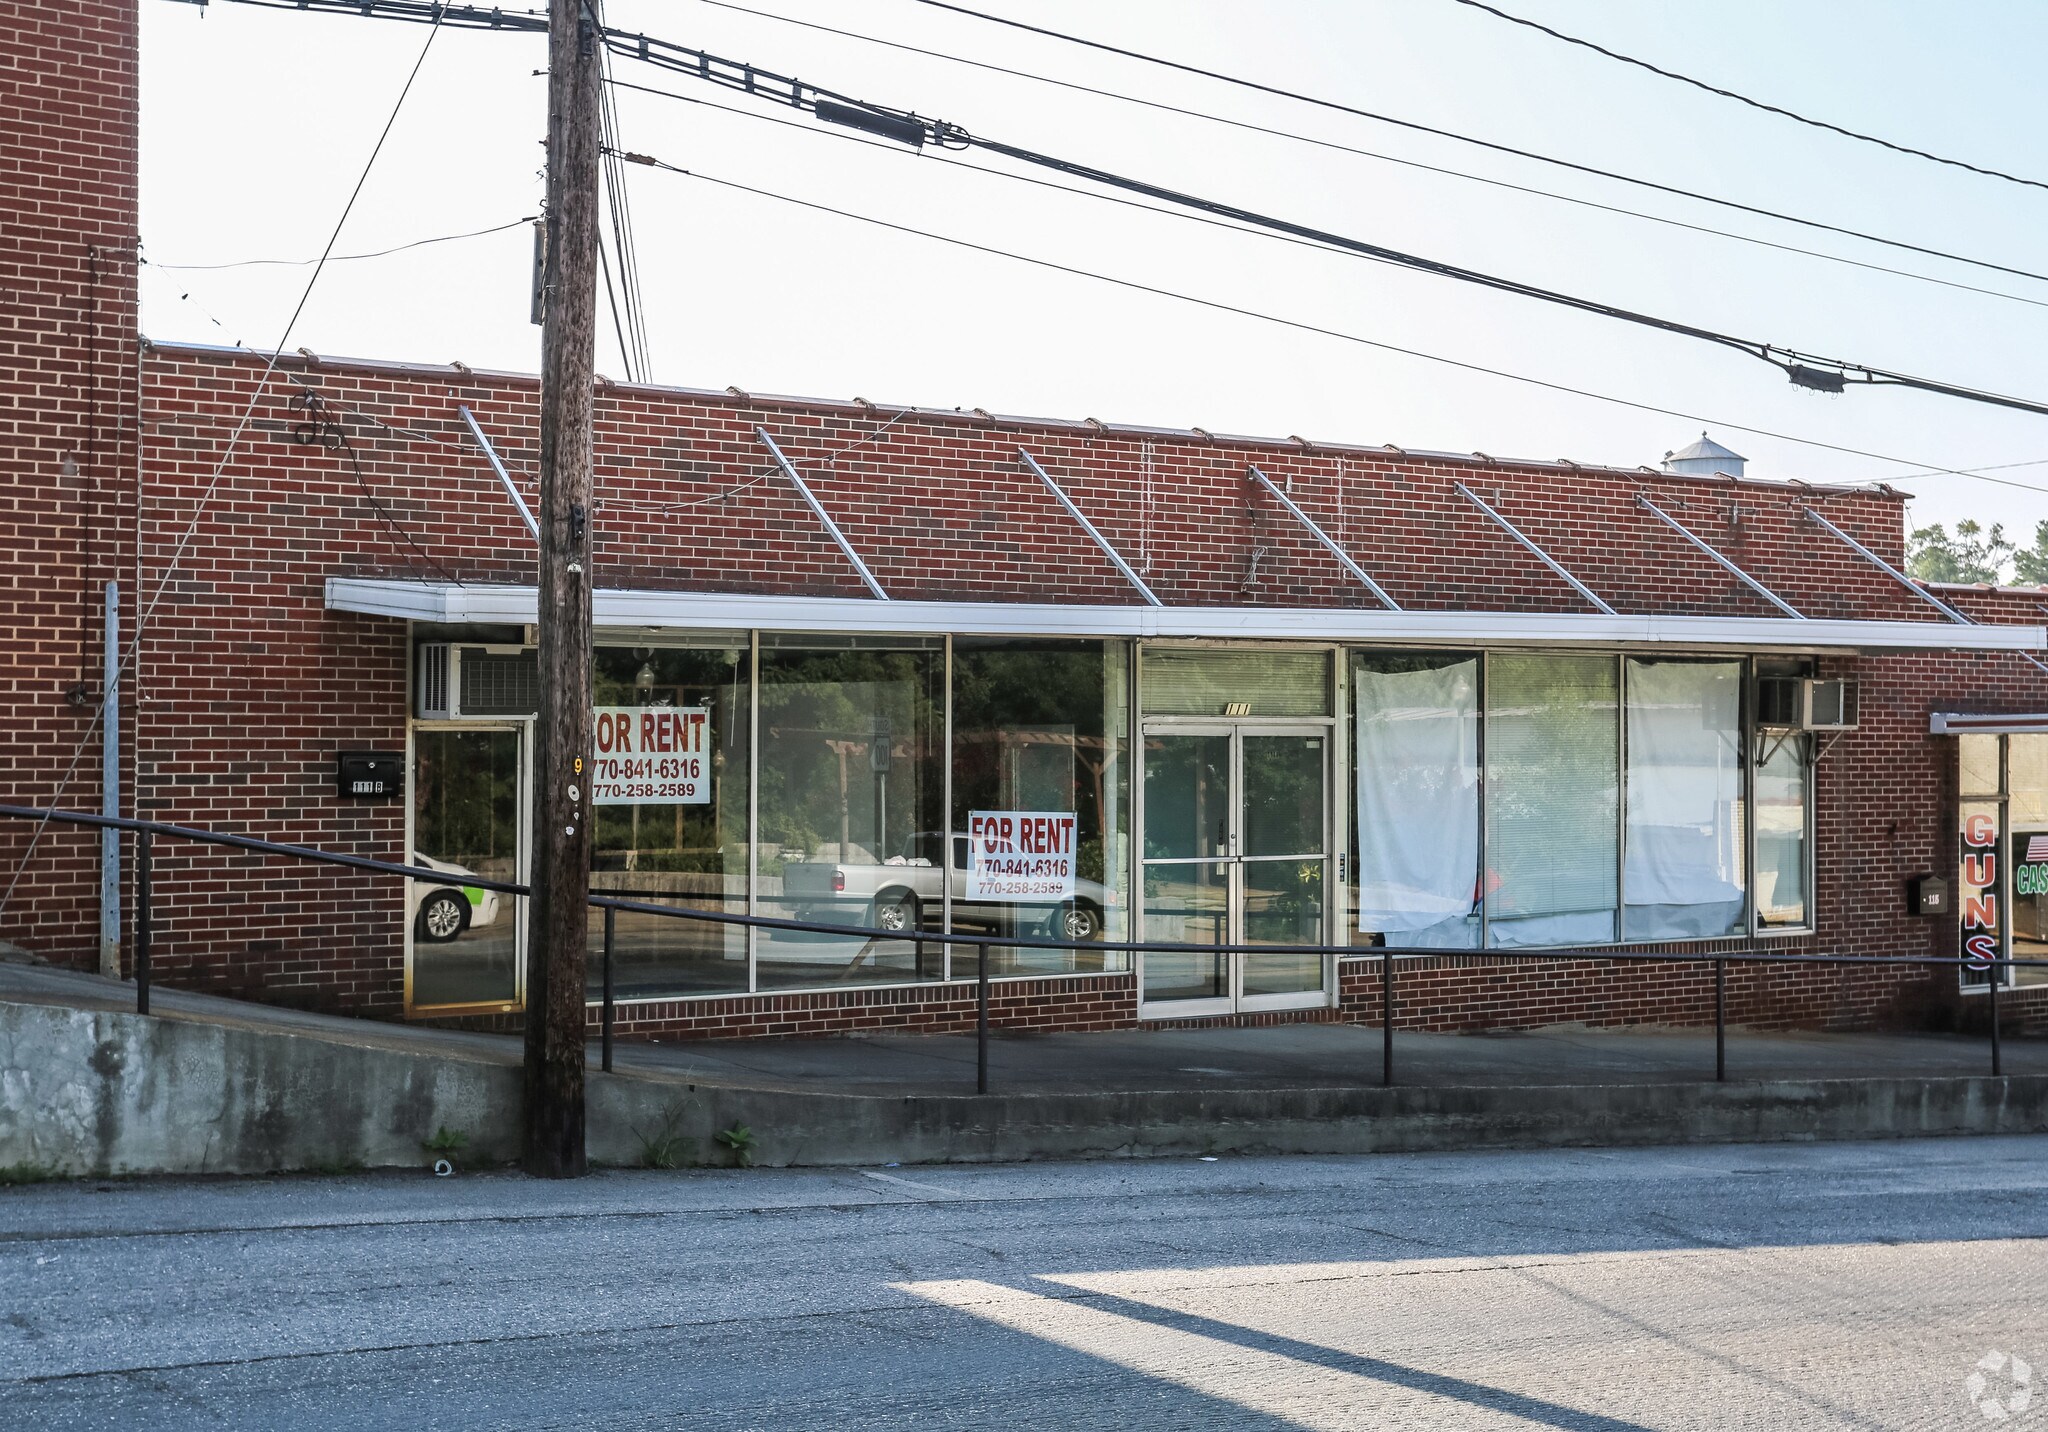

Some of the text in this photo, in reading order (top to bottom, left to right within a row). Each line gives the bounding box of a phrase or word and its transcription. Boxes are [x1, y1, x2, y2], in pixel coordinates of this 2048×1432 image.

[1228, 703, 1250, 716] 111
[593, 712, 706, 753] OR RENT
[574, 758, 583, 773] 9
[354, 782, 372, 792] 111
[593, 783, 696, 798] 770-258-2589
[971, 816, 1074, 854] FOR RENT
[975, 858, 1068, 878] 770-841-6316
[978, 881, 1063, 894] 770-258-2589
[1964, 814, 1996, 971] GUNS
